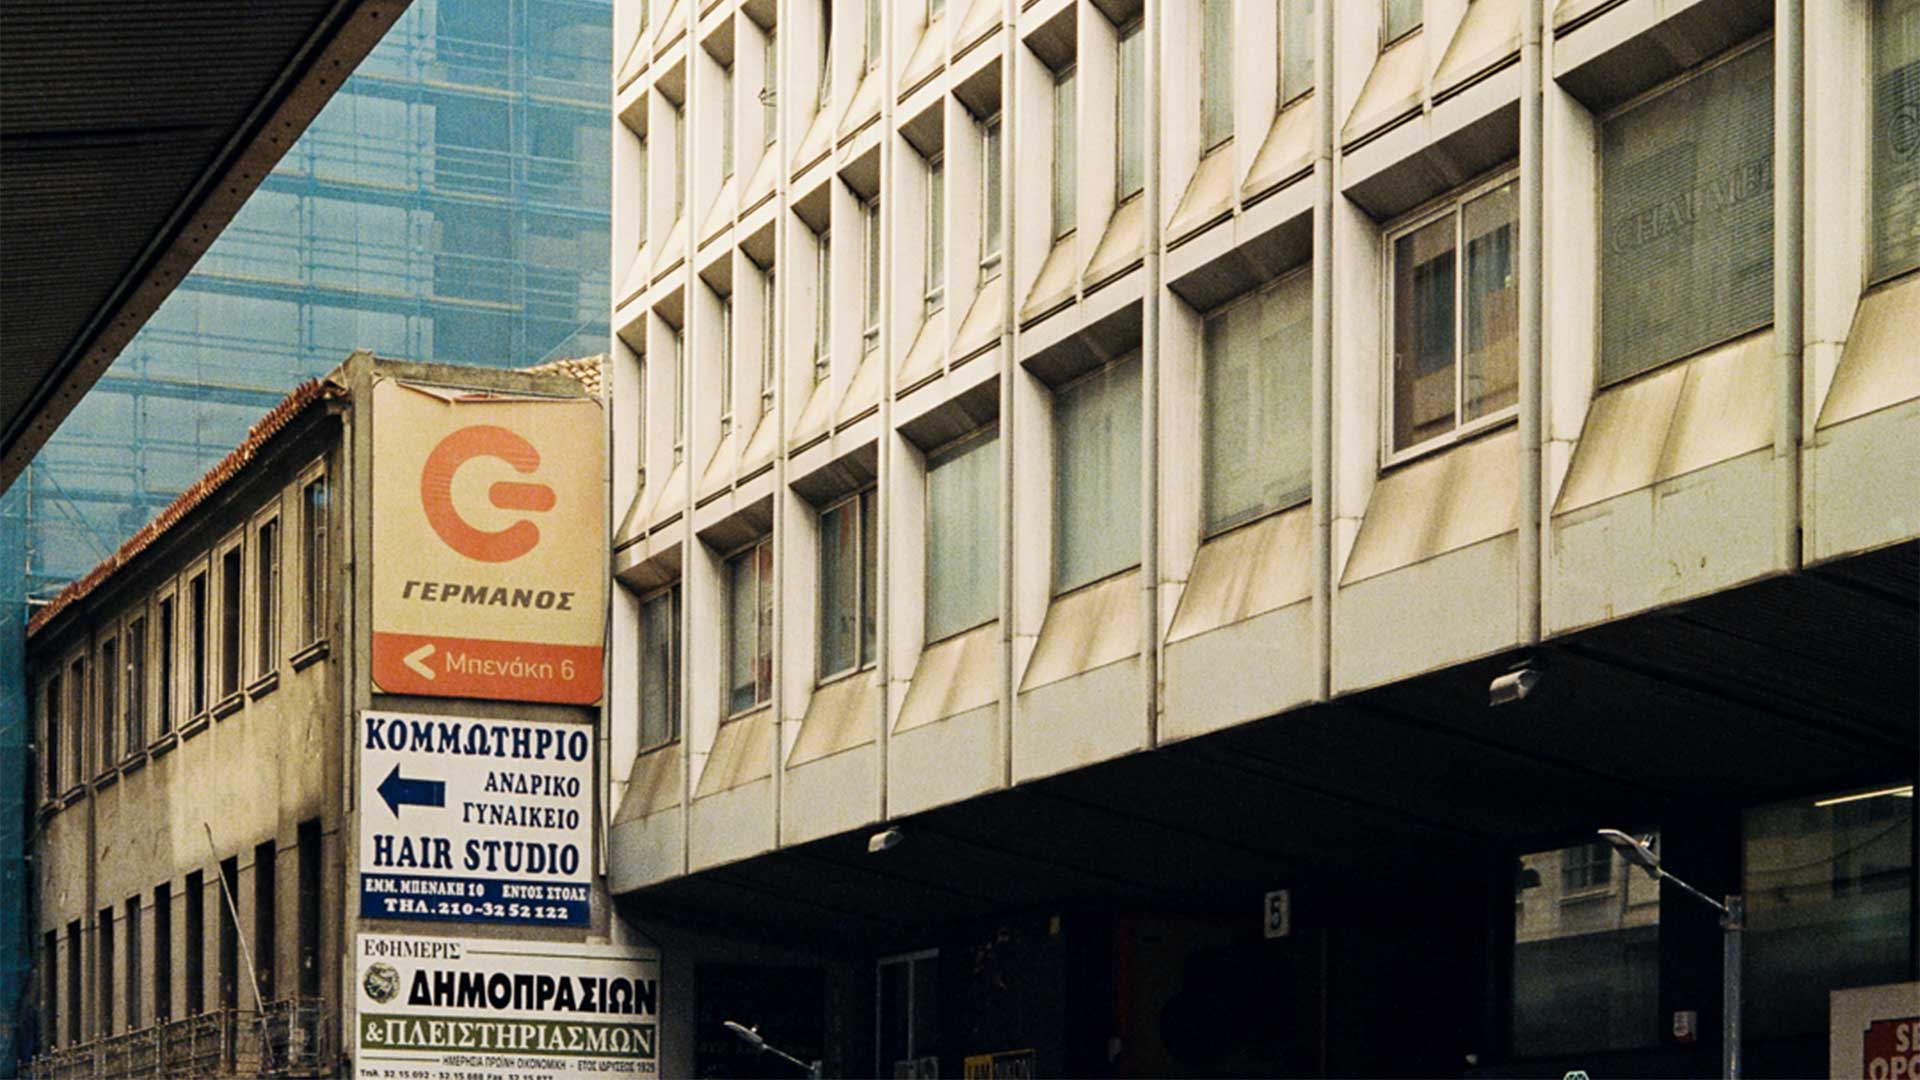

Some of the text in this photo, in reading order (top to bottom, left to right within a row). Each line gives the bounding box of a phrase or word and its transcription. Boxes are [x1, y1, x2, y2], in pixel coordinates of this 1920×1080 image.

[402, 580, 575, 611] ΓΕΡΜΑΝΟΣ
[445, 651, 575, 680] Μπενάκη 6
[365, 718, 588, 762] ΚΟΜΜΩΤΗΡΙΟ
[484, 771, 580, 797] ΑΝΔΡΙΚΟ
[463, 802, 580, 830] ΓΥΝΑΙΚΕΙΟ
[373, 834, 580, 876] HAIR STUDIO
[365, 878, 587, 901] ΕΜΜ. ΜΠΕΝΑΚΗ 10 ΕΝΤΟΣ ΣΤΟΑΣ
[364, 938, 461, 959] ΕΦΗΜΕΡΙΣ
[408, 969, 656, 1015] ΔΗΜΟΠΡΑΣΙΩΝ
[517, 1058, 566, 1070] ΟΙΚΟΝΟΜΙΚΗ
